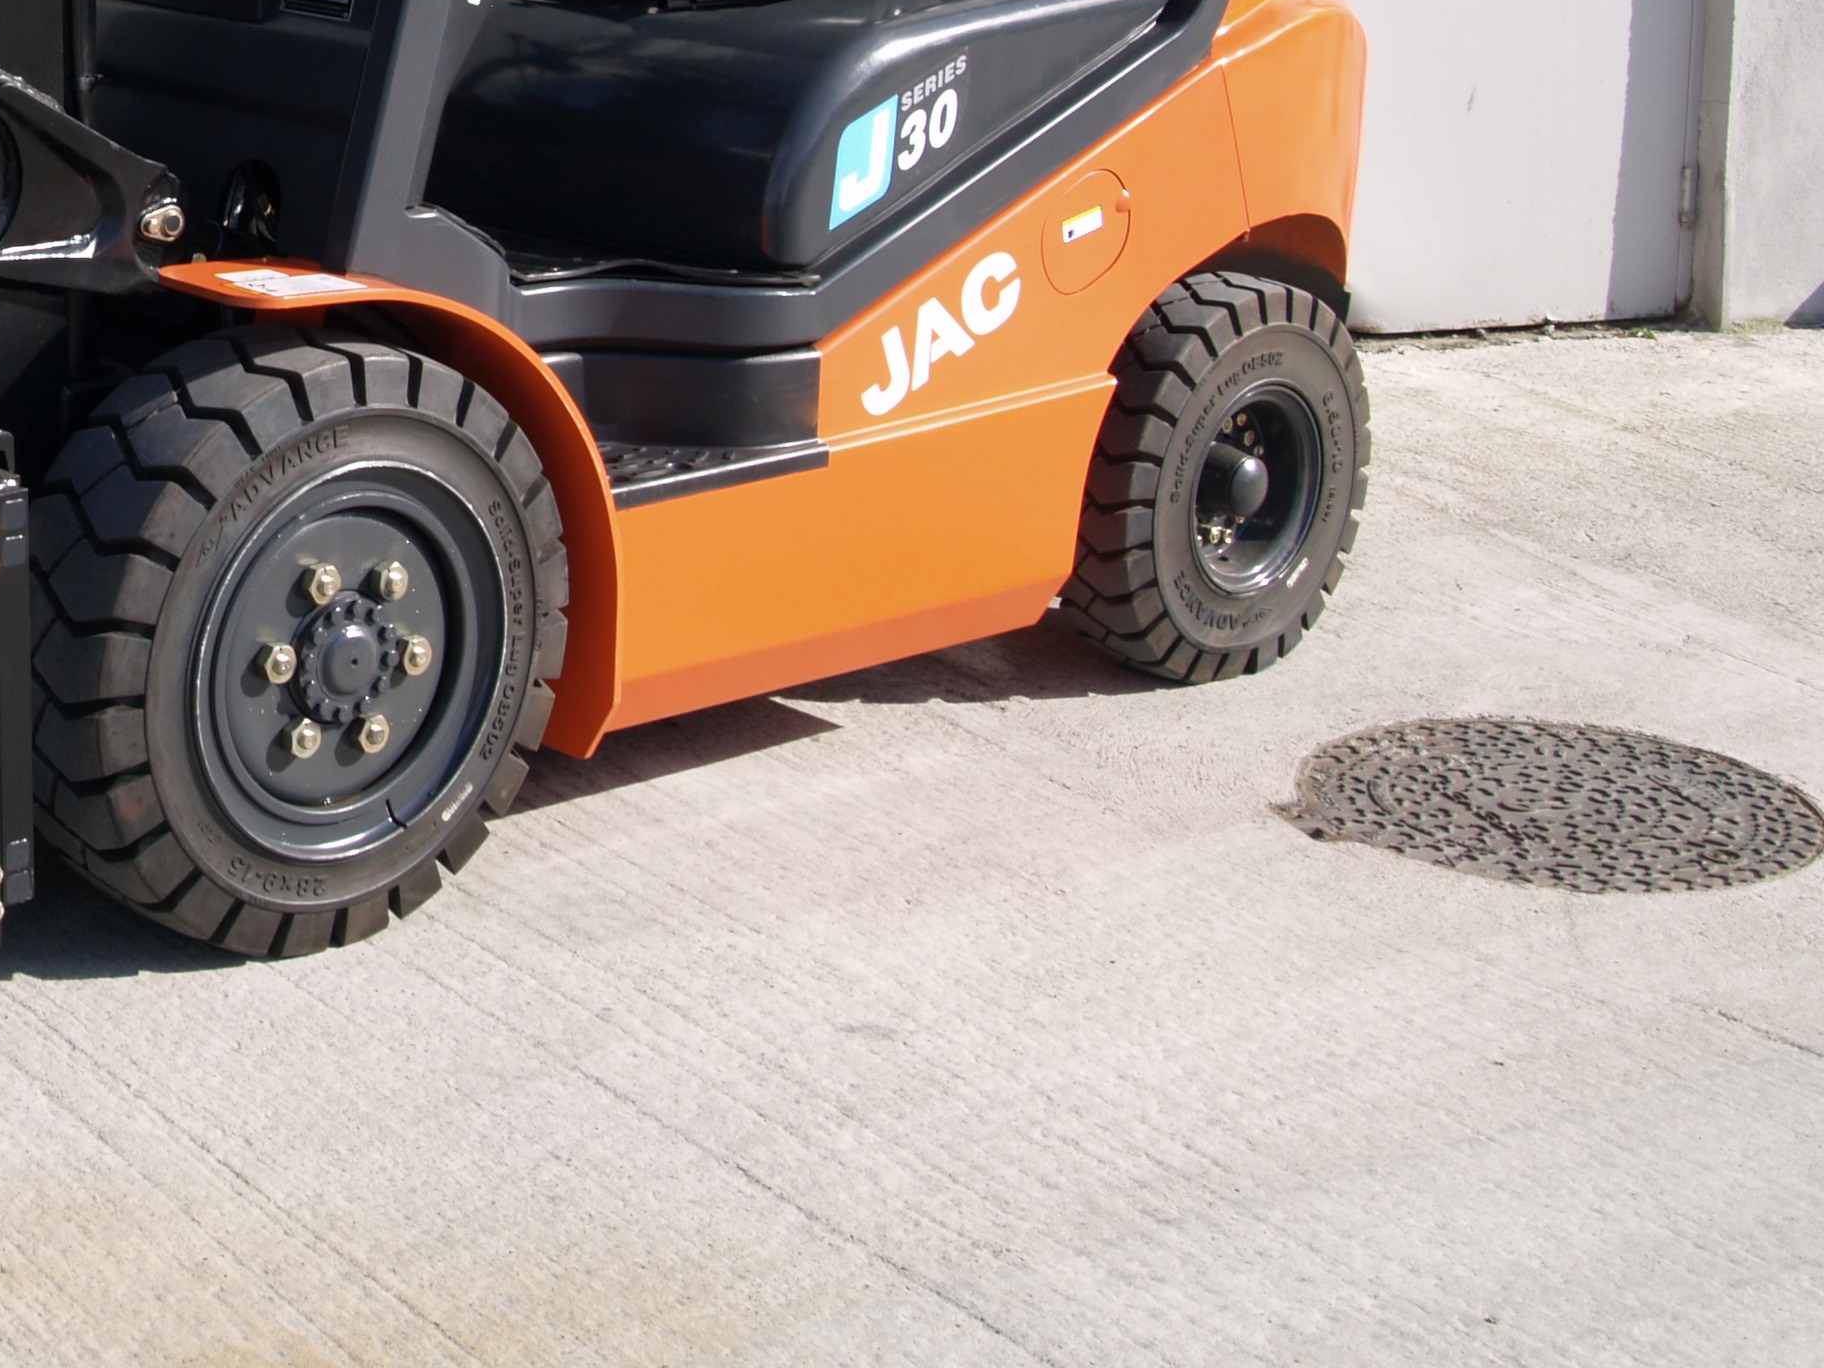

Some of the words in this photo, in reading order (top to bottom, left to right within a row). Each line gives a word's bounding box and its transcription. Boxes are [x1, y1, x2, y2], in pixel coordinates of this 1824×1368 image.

[900, 54, 968, 112] SERIES
[897, 88, 958, 171] 30
[861, 251, 1021, 416] JAC
[230, 425, 351, 522] ADVANCE
[488, 499, 524, 627] Solid-Super
[1173, 570, 1244, 632] ADVANCE
[505, 633, 526, 678] Lug
